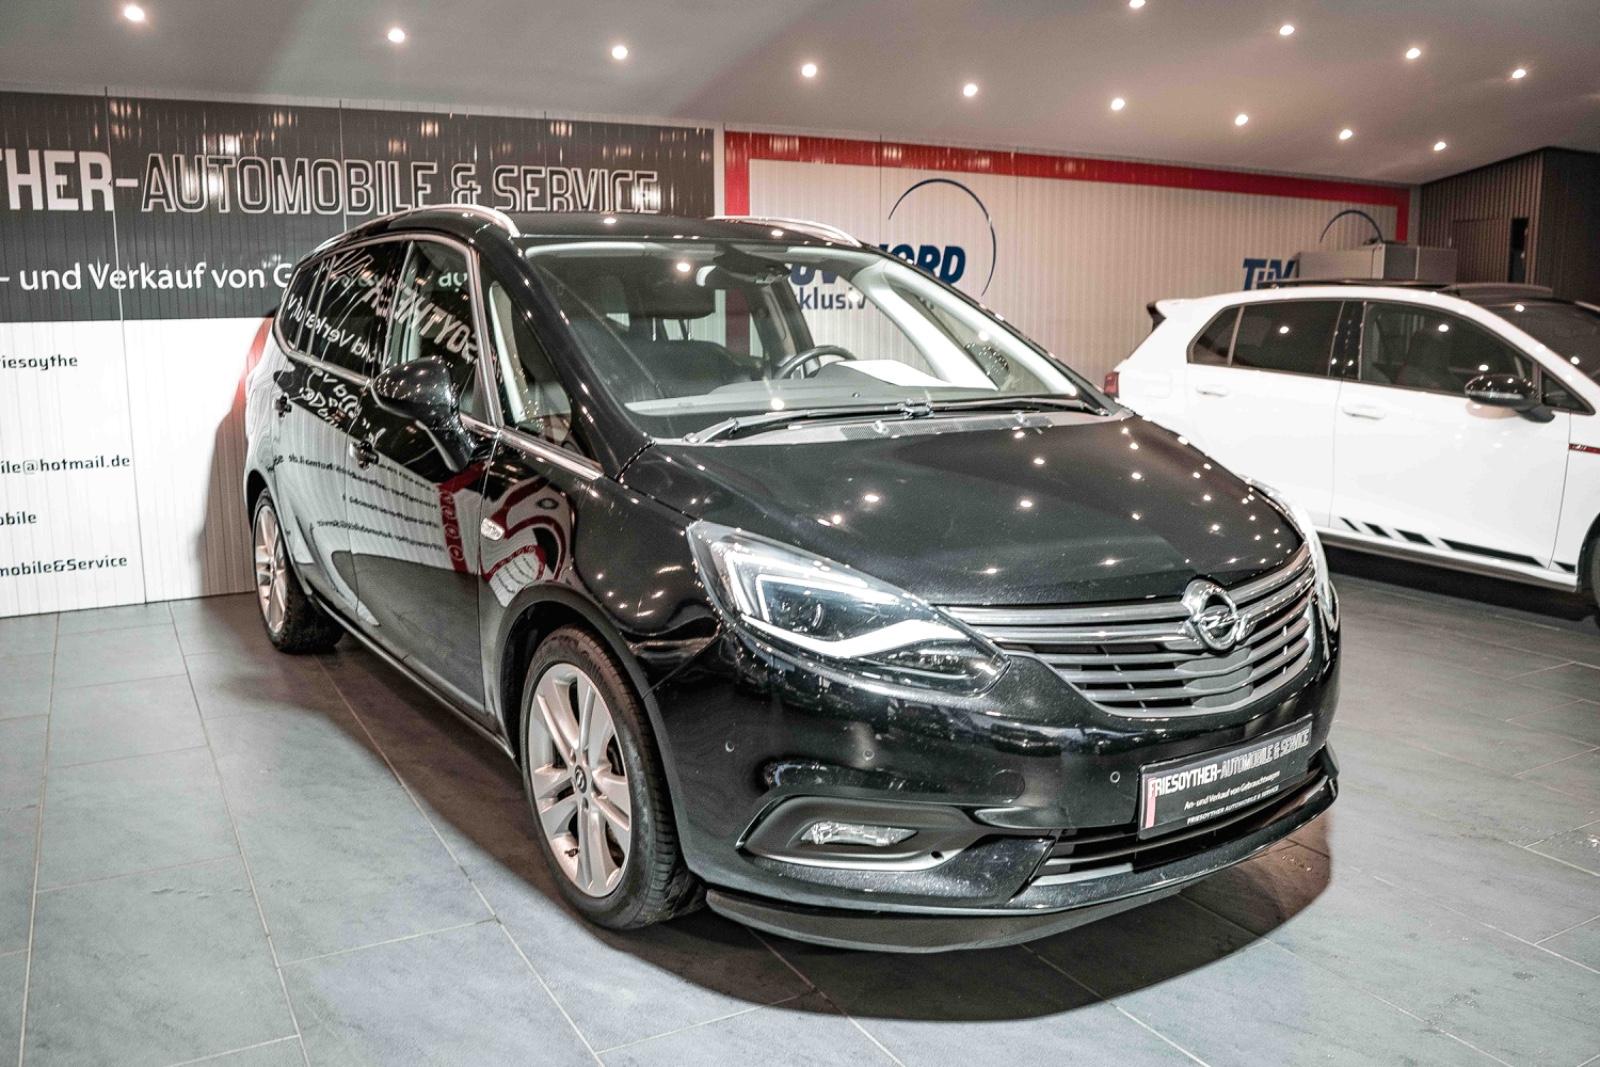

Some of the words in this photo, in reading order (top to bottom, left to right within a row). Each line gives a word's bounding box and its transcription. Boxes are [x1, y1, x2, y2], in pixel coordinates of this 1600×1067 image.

[0, 147, 438, 217] HER-AUTOMOBILE
[450, 162, 482, 206] &
[493, 165, 661, 214] SERVICE
[20, 262, 82, 290] und
[88, 262, 207, 290] Verkauf
[211, 267, 266, 289] von
[795, 286, 867, 310] klusiv
[0, 354, 78, 371] iesoythe
[1148, 744, 1275, 798] FRIESOYTHER-AUTOMOBILE
[1279, 728, 1311, 757] SERVICE
